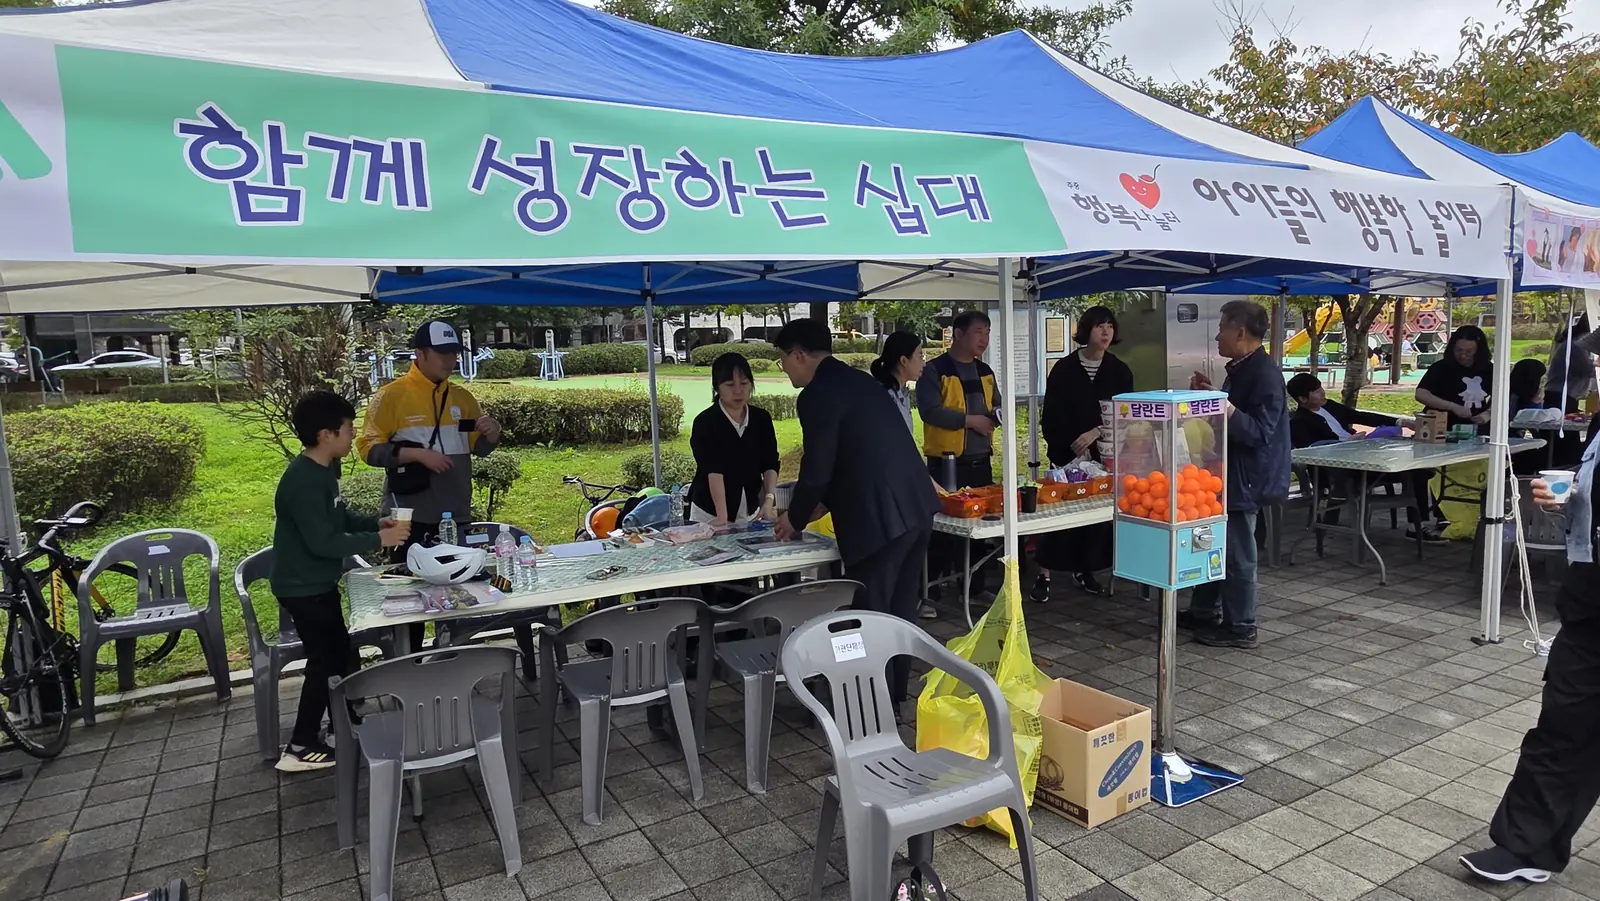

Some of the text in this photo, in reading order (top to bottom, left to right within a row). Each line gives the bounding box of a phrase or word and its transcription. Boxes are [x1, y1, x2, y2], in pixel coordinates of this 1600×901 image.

[176, 103, 991, 236] 함께 성장하는 십대
[1071, 193, 1181, 231] 행복나눔터
[1192, 178, 1482, 258] 아이들의 행복한 놀이터
[1130, 403, 1165, 417] 달란트
[1190, 398, 1220, 415] 달란트
